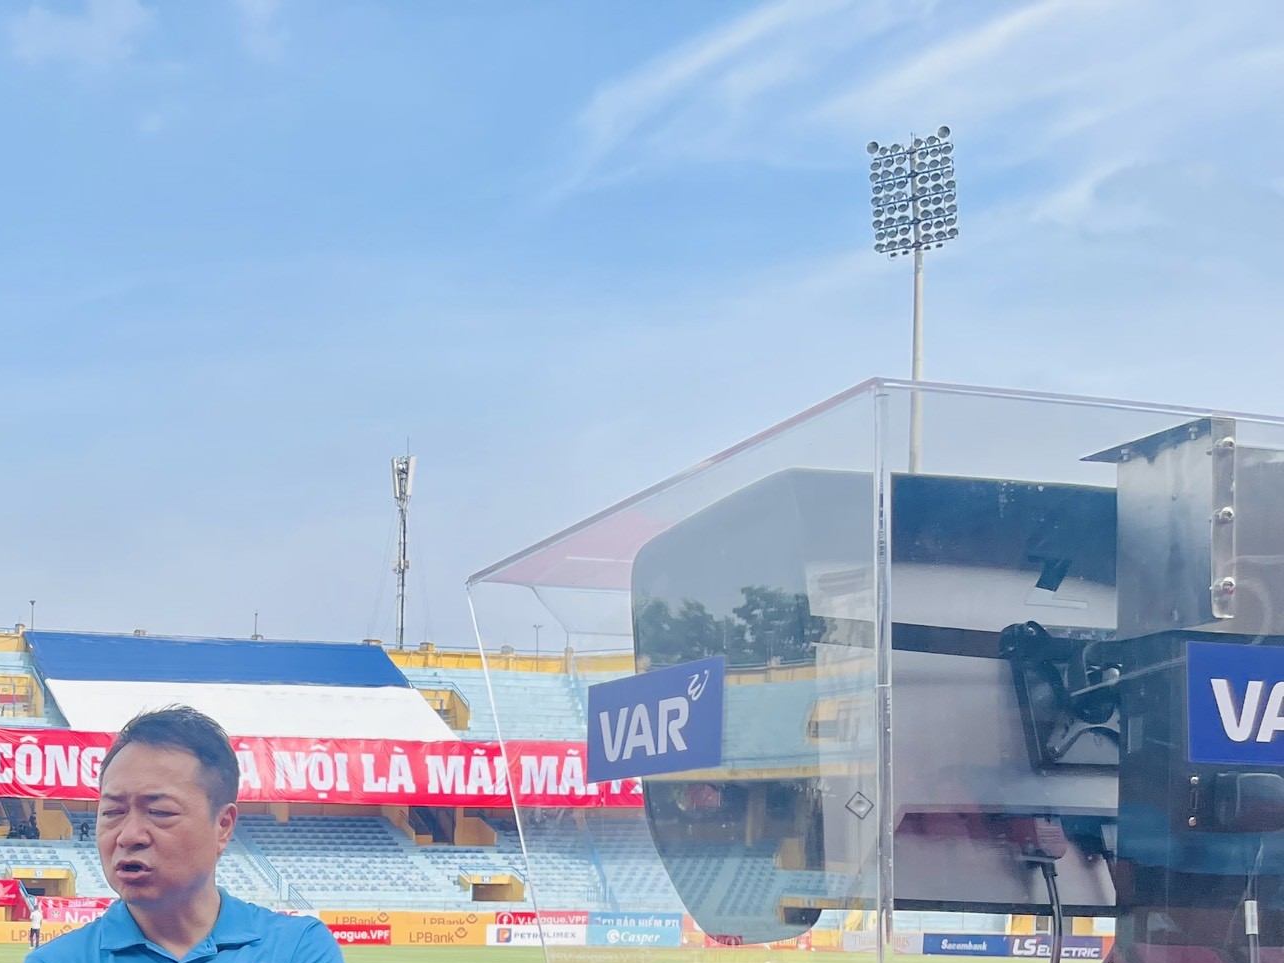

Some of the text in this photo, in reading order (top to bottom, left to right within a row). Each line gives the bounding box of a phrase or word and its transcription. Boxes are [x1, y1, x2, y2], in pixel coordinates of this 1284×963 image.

[599, 696, 688, 763] VAR
[272, 744, 350, 799] NỘI
[361, 746, 416, 793] LÀ
[425, 748, 508, 795] MÃI
[11, 930, 61, 941] LPank
[409, 931, 455, 943] LPBank
[621, 932, 660, 945] Casper
[941, 939, 987, 951] Sacombank
[1013, 939, 1100, 957] LS ELCTRIC
